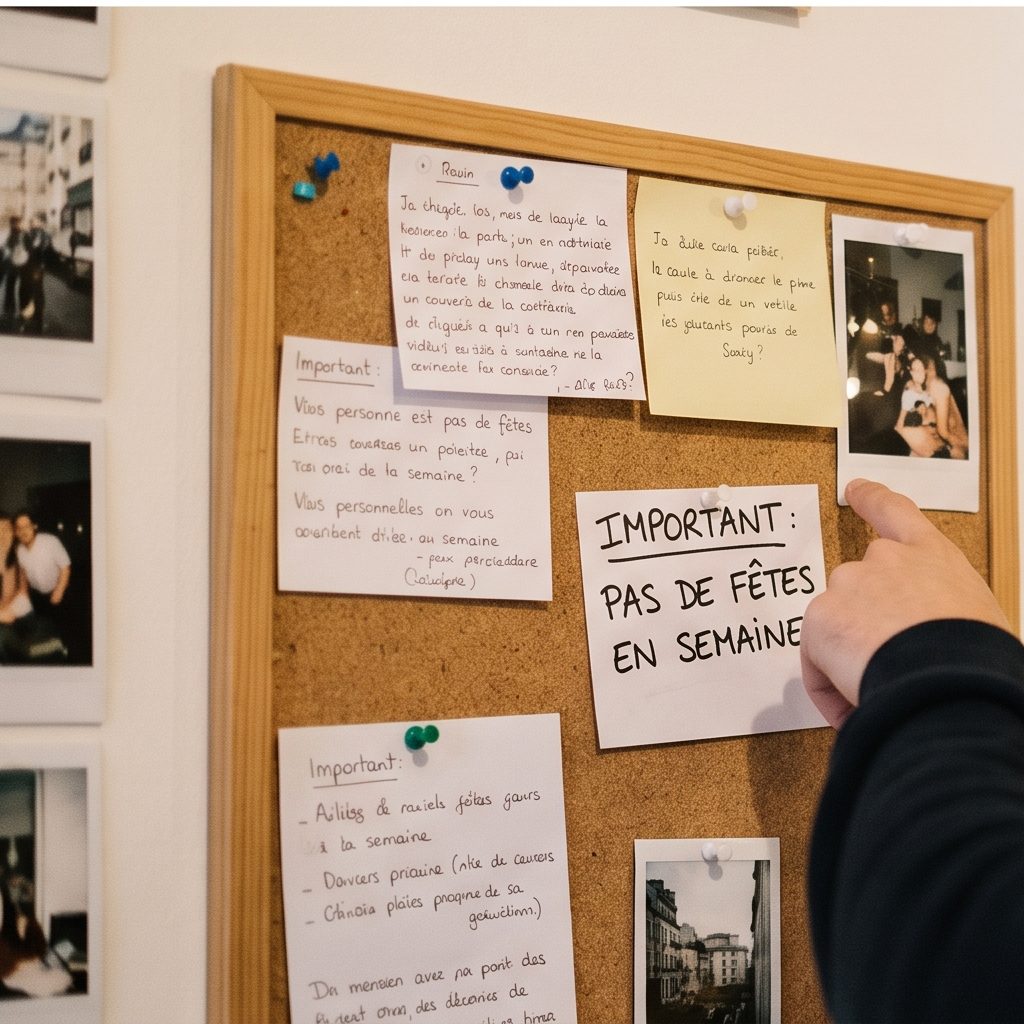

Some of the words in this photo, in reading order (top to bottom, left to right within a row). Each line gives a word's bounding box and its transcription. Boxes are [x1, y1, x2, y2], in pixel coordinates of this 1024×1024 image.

[528, 210, 542, 223] de
[596, 215, 608, 227] la
[540, 239, 553, 247] en
[773, 274, 782, 286] le
[478, 297, 494, 309] de
[502, 299, 514, 310] la
[718, 294, 732, 306] de
[740, 300, 755, 308] un
[785, 325, 798, 337] de
[591, 348, 602, 360] la
[336, 407, 401, 424] personne
[411, 410, 432, 424] est
[444, 417, 466, 433] pas
[475, 414, 491, 429] de
[409, 444, 427, 452] un
[359, 463, 376, 476] de
[336, 498, 424, 518] personnelles
[435, 507, 453, 517] on
[463, 508, 494, 519] vous
[443, 535, 500, 546] semaine
[600, 583, 661, 620] PAS
[674, 576, 714, 610] DE
[730, 558, 815, 603] FÊTES
[613, 638, 657, 673] EN
[366, 829, 432, 848] semaine
[485, 885, 500, 897] de
[415, 970, 445, 985] avez
[522, 952, 546, 966] des
[416, 1000, 436, 1012] des
[509, 984, 528, 998] de
